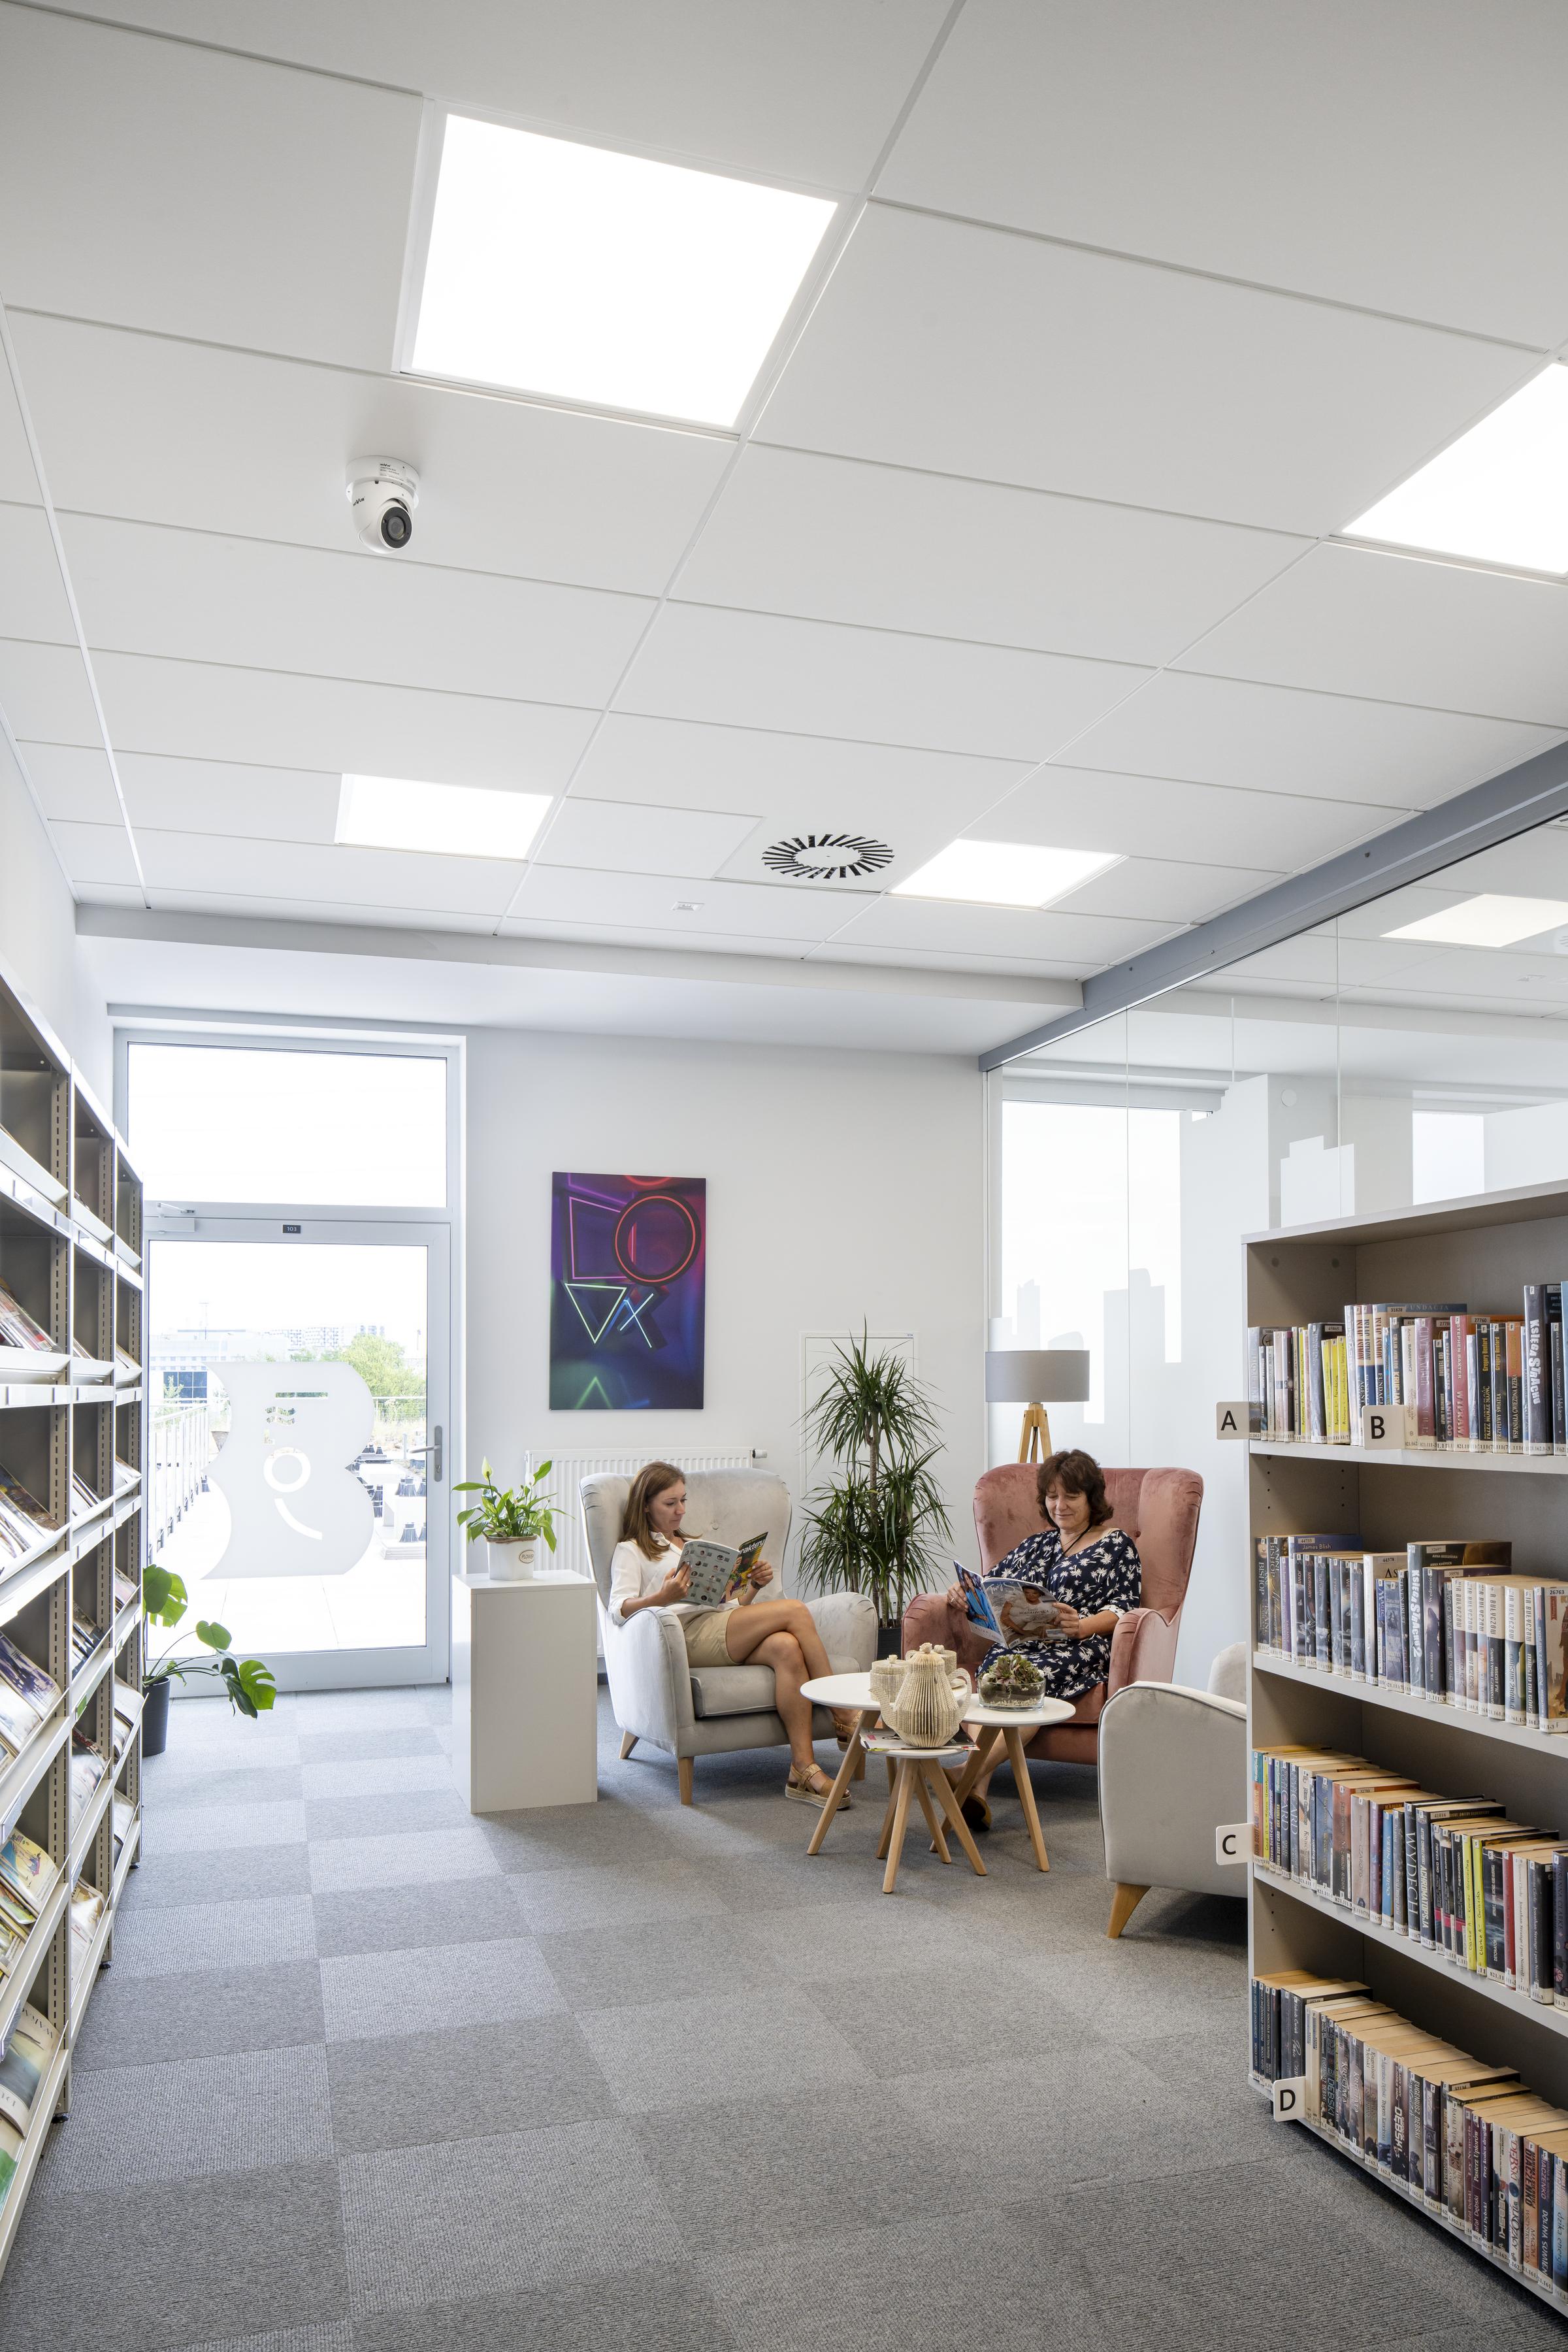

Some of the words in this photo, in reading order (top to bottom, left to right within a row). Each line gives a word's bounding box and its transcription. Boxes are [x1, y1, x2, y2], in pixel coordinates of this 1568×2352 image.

[1529, 1319, 1540, 1356] KSIĘGA
[1529, 1358, 1541, 1404] STRACHU
[1221, 1411, 1237, 1430] A
[1371, 1416, 1385, 1438] B
[740, 1539, 765, 1554] raktery
[1411, 1570, 1420, 1603] KSIĘGA
[1411, 1603, 1421, 1647] STRACHU
[1413, 1646, 1422, 1658] 2
[1222, 1835, 1236, 1855] C
[1406, 1831, 1418, 1914] WYDECH
[1280, 2089, 1296, 2111] D
[1394, 2106, 1403, 2153] DĘBSKI
[1509, 2140, 1518, 2181] DĘBSKI
